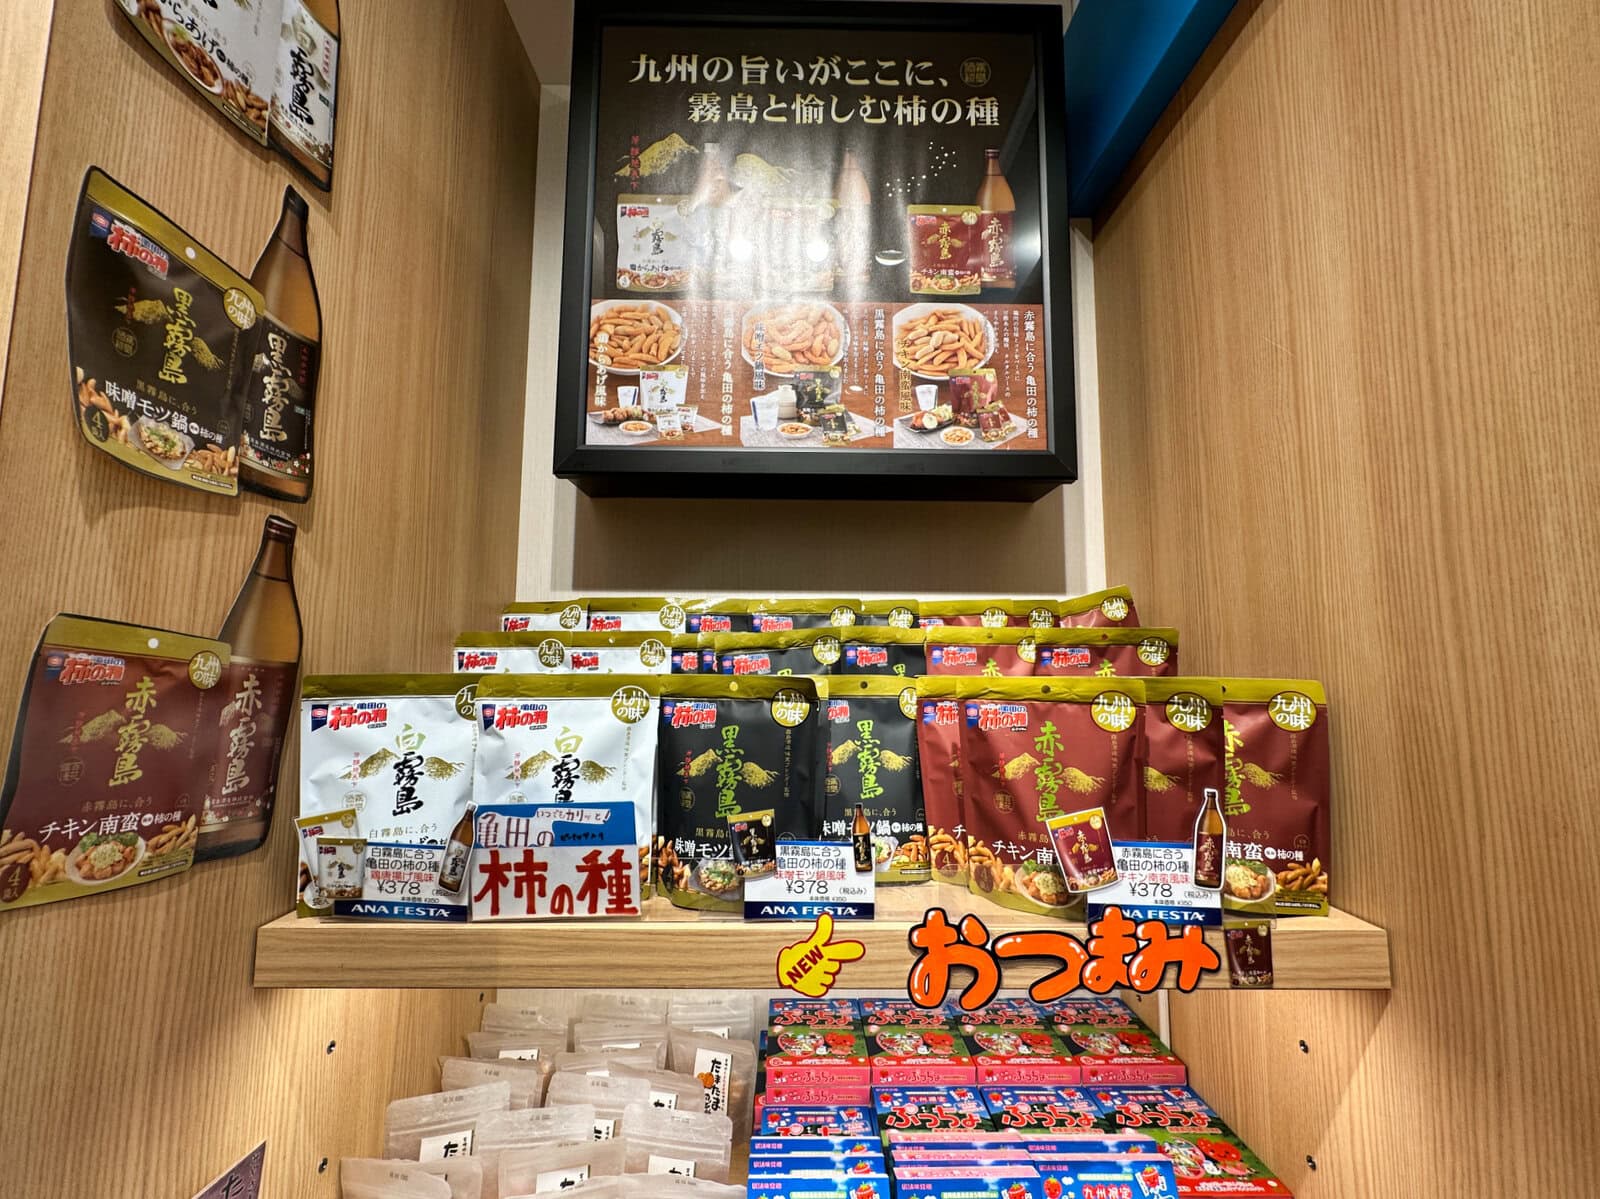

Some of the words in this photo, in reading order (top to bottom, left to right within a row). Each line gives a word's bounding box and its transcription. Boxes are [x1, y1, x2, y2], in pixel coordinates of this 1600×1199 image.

[629, 53, 949, 87] 九州の旨いがここに、
[687, 91, 1001, 127] 霧島と愉しむ柿の種
[227, 288, 257, 317] 九州
[227, 304, 252, 330] の味
[158, 287, 198, 385] 黒霧島
[259, 332, 292, 444] 黒霧島
[104, 379, 189, 434] 味噌モツ鍋
[562, 605, 581, 618] 九州
[660, 604, 683, 618] 九州
[1102, 597, 1127, 611] 九州
[561, 615, 579, 629] の味
[661, 615, 680, 629] の味
[832, 607, 856, 620] 九州
[889, 608, 914, 621] 九州
[982, 608, 1008, 621] 九州
[1029, 608, 1054, 622] 九州
[1105, 607, 1127, 620] の味
[541, 641, 564, 655] 九州
[643, 641, 666, 655] 九州
[815, 638, 840, 652] 九州
[1140, 639, 1168, 653] 九州
[192, 654, 221, 672] 九州
[541, 652, 561, 666] の味
[644, 653, 662, 666] の味
[817, 649, 841, 664] の味
[1141, 650, 1166, 665] の味
[193, 669, 217, 689] の味
[613, 690, 647, 708] 九州
[775, 690, 806, 710] 九州
[1095, 694, 1131, 715] 九州
[1168, 696, 1207, 716] 九州
[1271, 694, 1311, 715] 九州
[328, 706, 388, 731] 柿の種
[495, 706, 549, 731] 柿の種
[616, 705, 645, 721] の味
[671, 705, 717, 729] 柿の種
[776, 706, 804, 724] の味
[978, 708, 1029, 731] 柿の種
[1097, 711, 1131, 729] の味
[1172, 712, 1207, 731] の味
[1275, 712, 1311, 731] の味
[108, 675, 158, 788] 赤霧島
[220, 673, 262, 796] 赤霧島
[854, 719, 885, 800] 黒霧島
[392, 722, 427, 817] 白霧島
[714, 724, 745, 819] 黒霧島
[1033, 720, 1065, 823] 赤霧島
[843, 807, 898, 818] 黒島に、合う
[39, 811, 141, 841] チキン南蛮
[478, 812, 555, 849] 亀田の
[371, 847, 436, 860] 白霧島に合う
[674, 836, 735, 859] 味噌モツ
[780, 846, 842, 858] 黒霧島に合う
[1121, 847, 1184, 860] 赤霧島に合う
[1276, 850, 1304, 862] 柿の種
[365, 857, 440, 873] 亀田の柿の種
[776, 857, 847, 870] 亀田の柿の種
[1116, 859, 1190, 873] 亀田の柿の種
[473, 848, 640, 917] 柿の種
[774, 870, 847, 881] 味噌モツ鍋風味
[1119, 872, 1191, 885] チキン南蛮風味
[377, 879, 421, 896] ¥378
[786, 880, 829, 895] ¥378
[1129, 882, 1173, 898] ¥378
[351, 903, 390, 915] ANA
[393, 905, 451, 918] FESTA
[760, 905, 799, 916] ANA
[801, 905, 859, 916] FESTA
[1147, 909, 1206, 921] FESTA
[785, 944, 824, 985] NEW
[907, 905, 1221, 1010] おつまみ
[774, 1009, 853, 1026] ぷっちょ
[868, 1009, 946, 1026] ぷっちょ
[961, 1009, 1040, 1026] ぷっちょ
[1053, 1007, 1132, 1026] ぷっちょ
[886, 1104, 982, 1129] ぷっちょ
[1001, 1102, 1097, 1128] ぷっちょ
[1115, 1101, 1211, 1128] ぷっちょ
[1082, 1184, 1133, 1199] 九州限定
